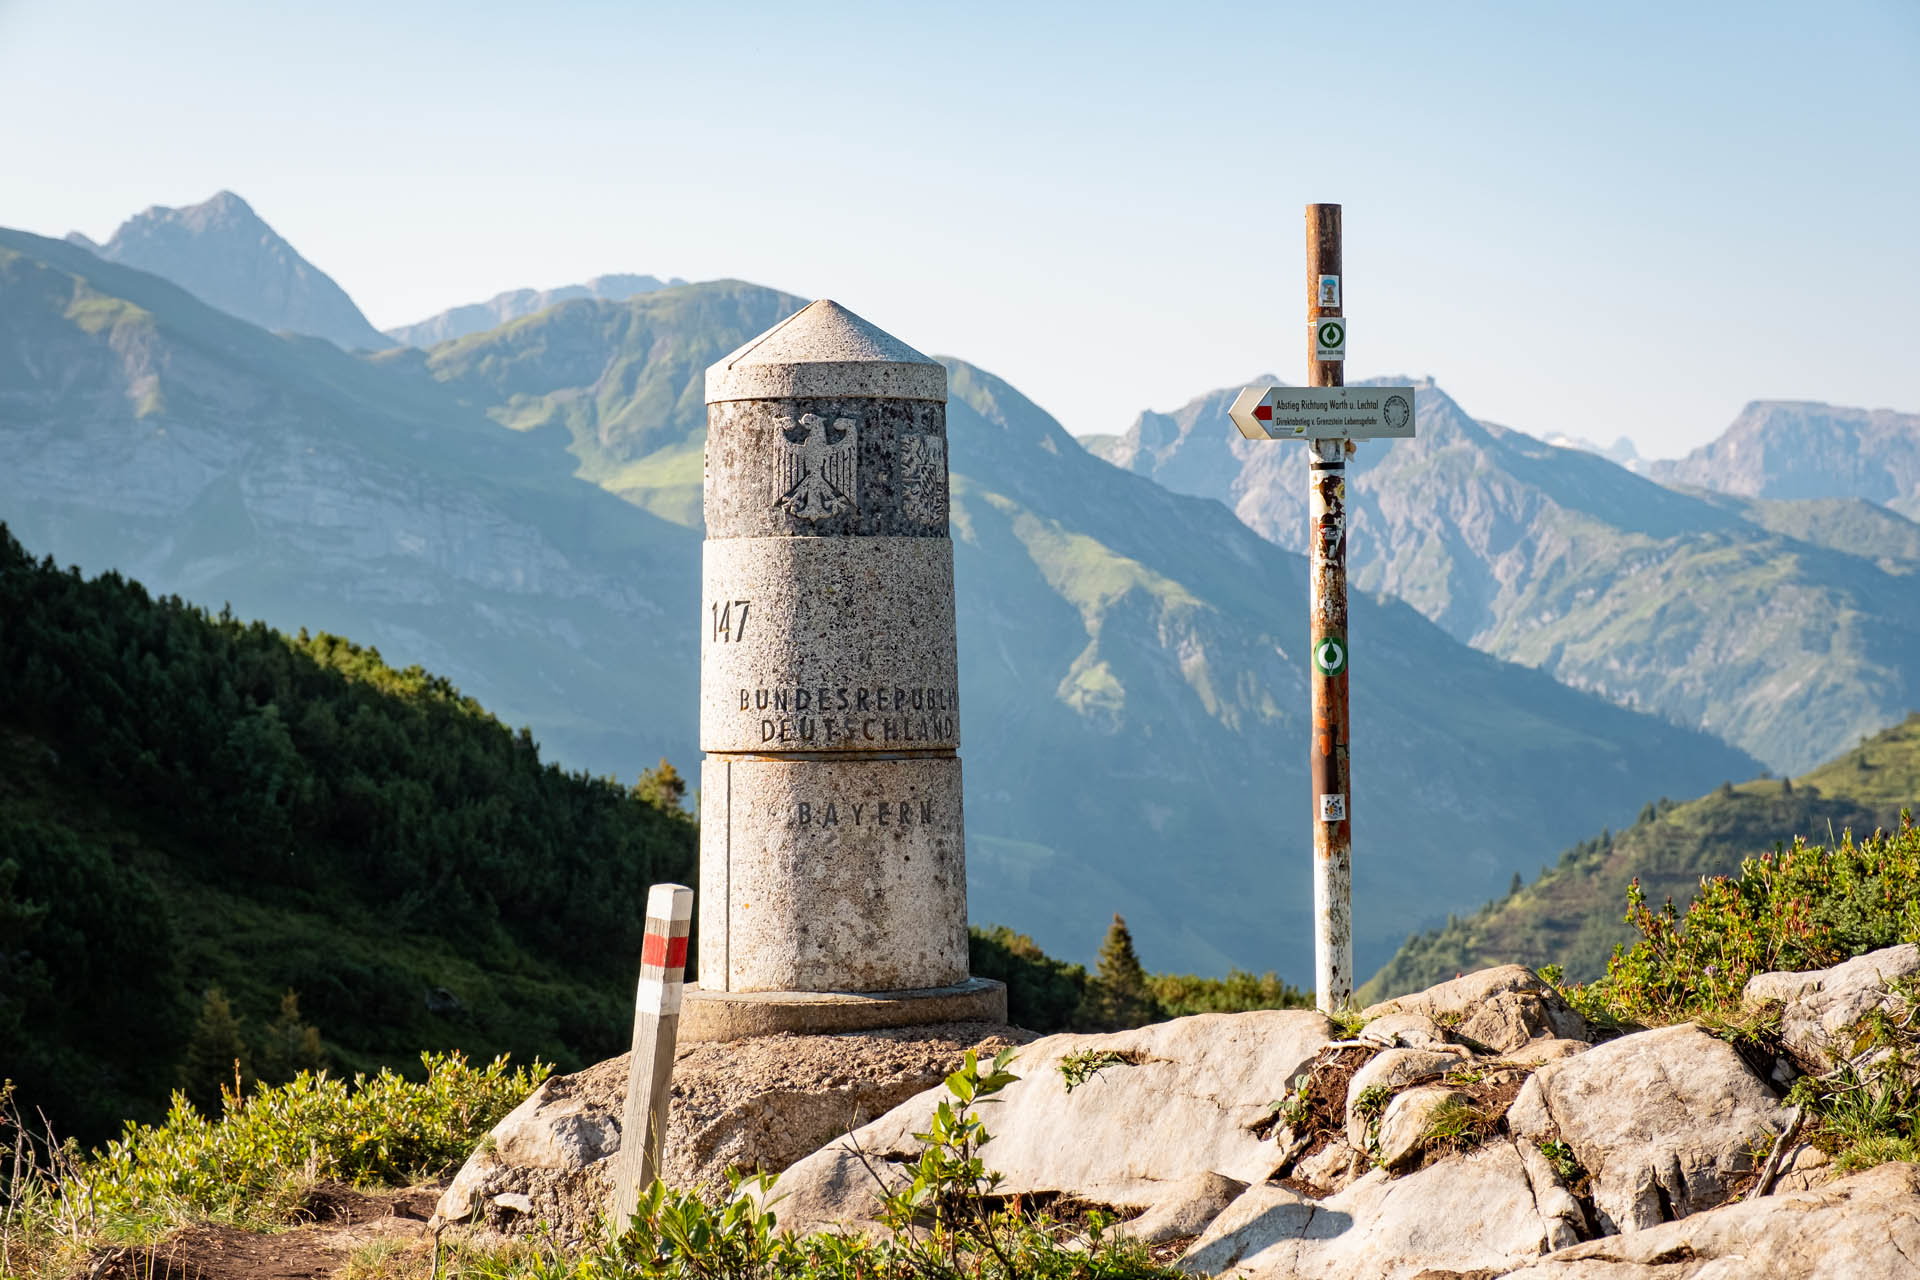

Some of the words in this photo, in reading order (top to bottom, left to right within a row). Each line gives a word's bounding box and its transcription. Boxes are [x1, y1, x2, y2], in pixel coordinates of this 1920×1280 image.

[1276, 400, 1300, 412] Abstieg
[1301, 400, 1328, 412] Richtung
[1357, 400, 1379, 410] Lechtal
[712, 600, 750, 643] 147
[761, 717, 954, 744] DEUTSCHLAND
[797, 802, 933, 826] BAYERN
